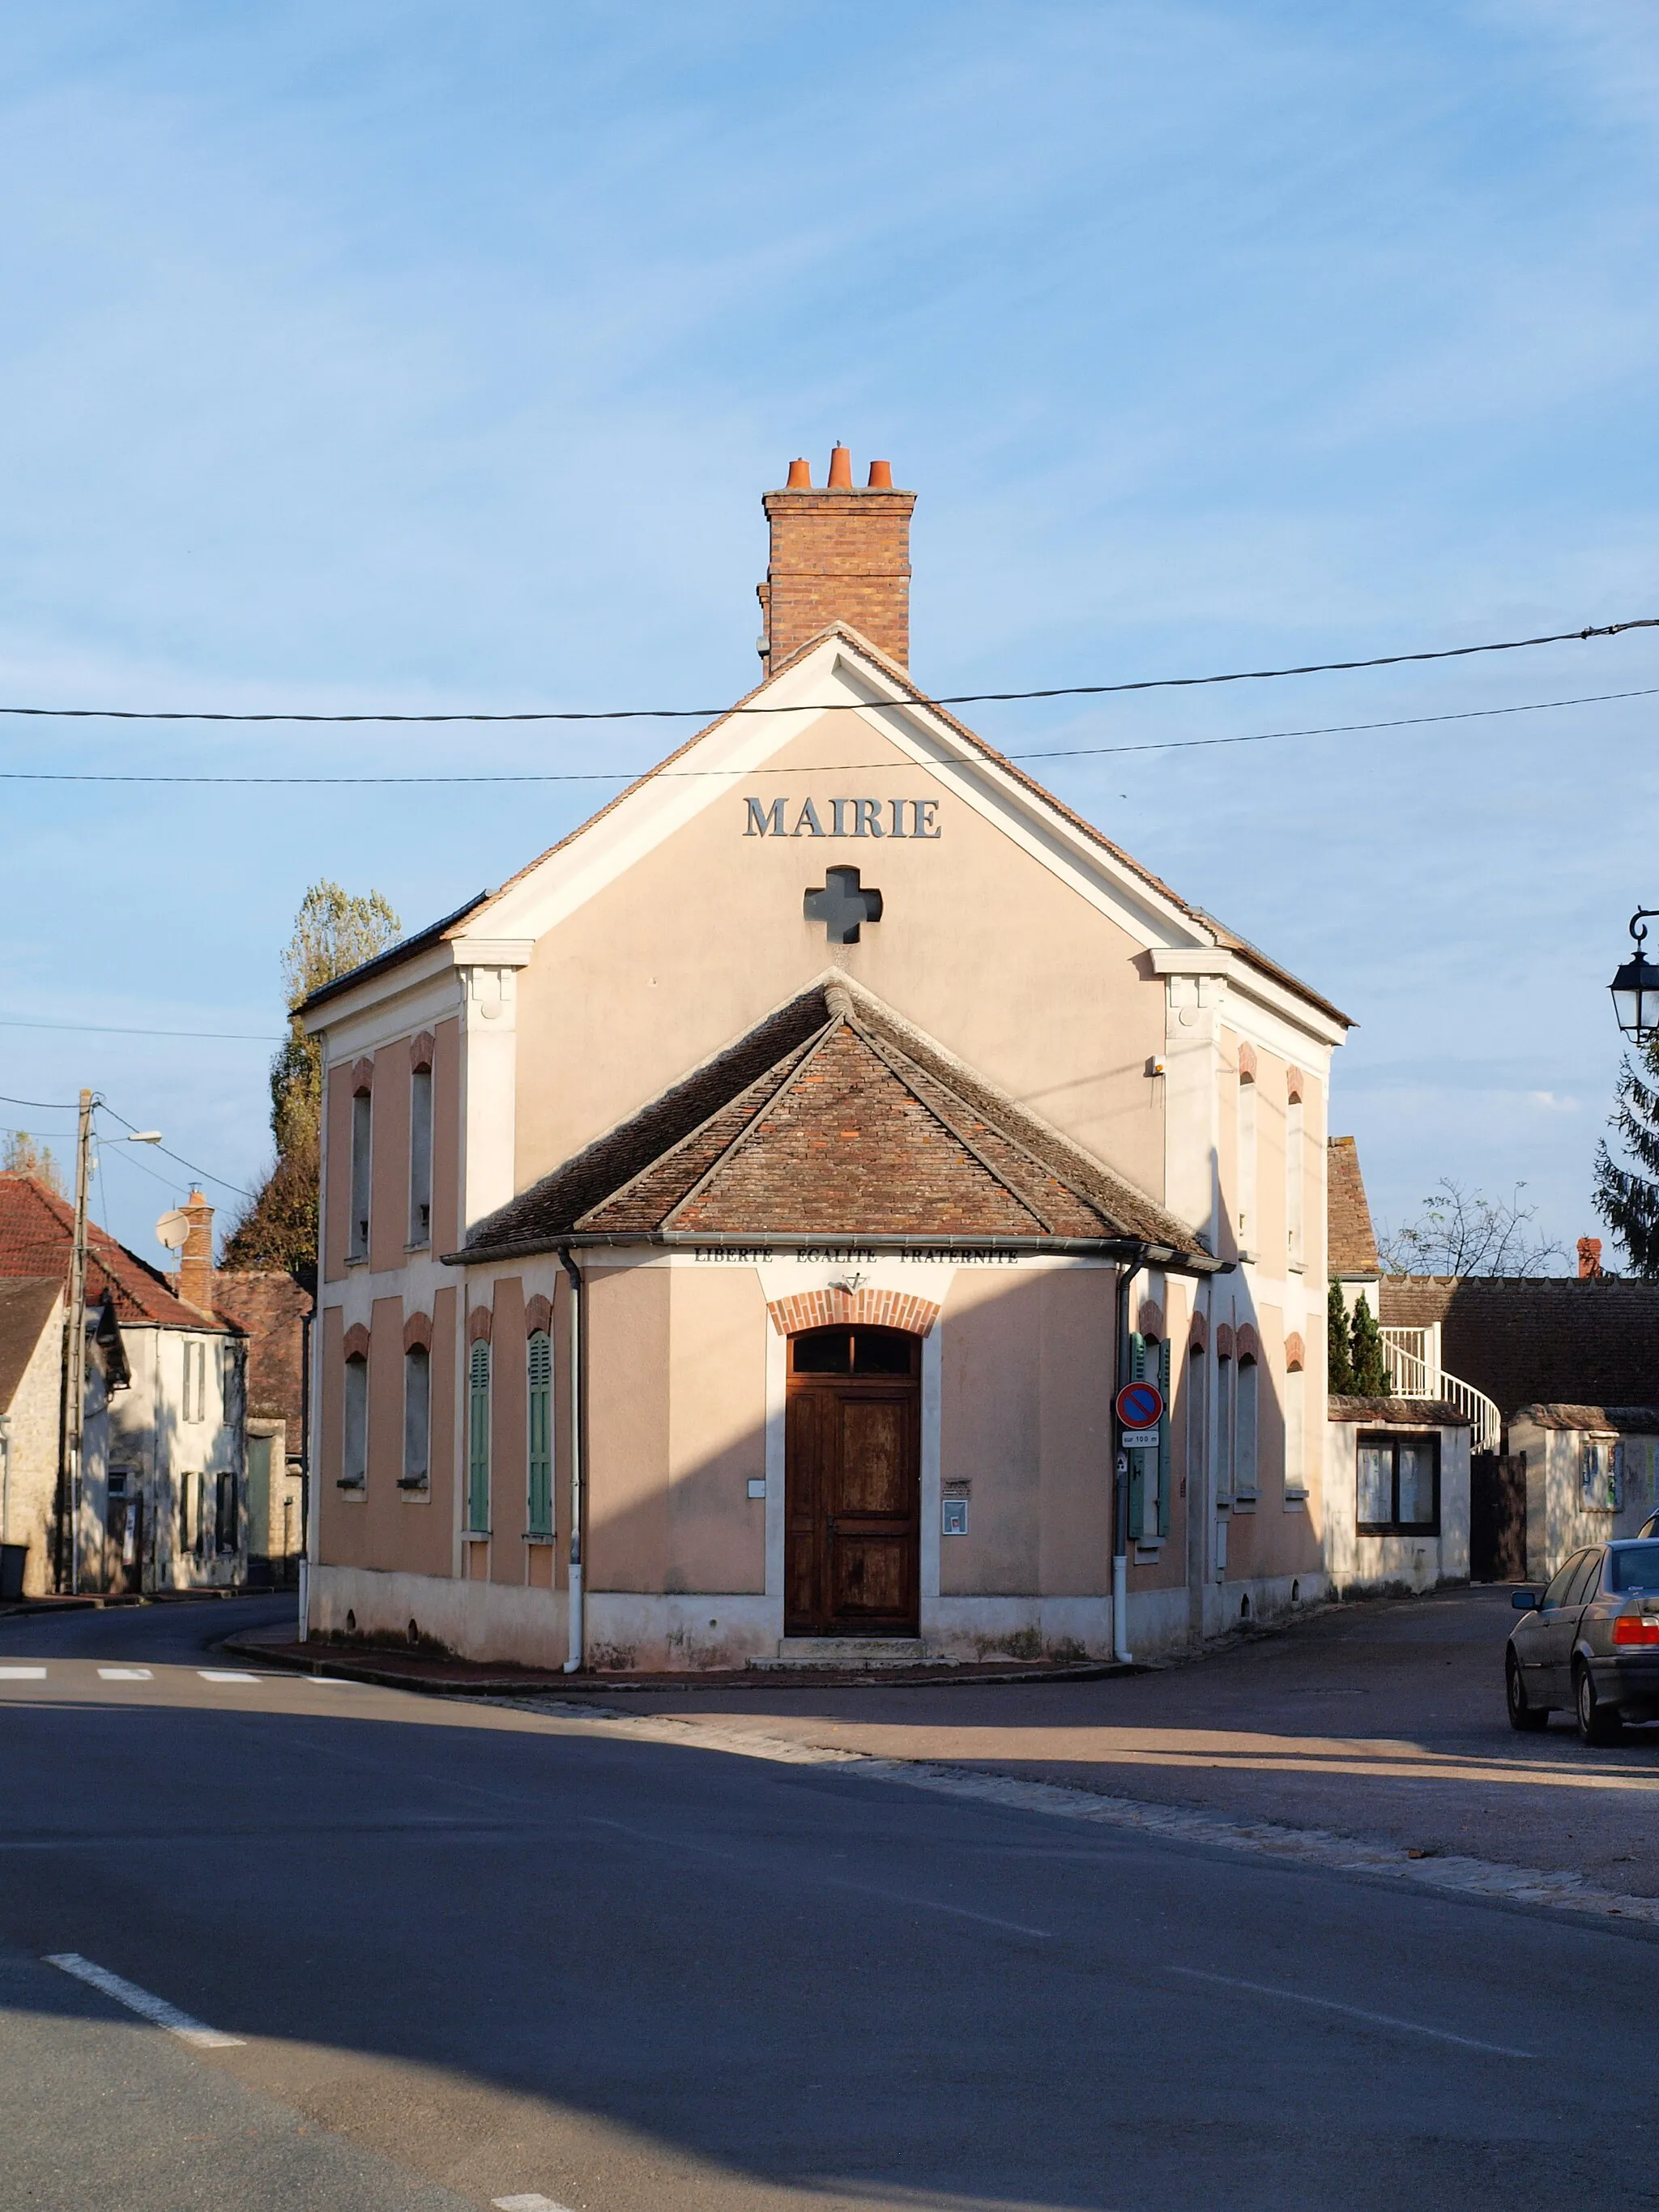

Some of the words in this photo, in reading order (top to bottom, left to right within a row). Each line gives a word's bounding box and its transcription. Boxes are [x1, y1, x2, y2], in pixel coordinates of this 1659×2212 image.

[742, 797, 942, 837] MAIRIE
[694, 1247, 773, 1263] LIBERTE
[795, 1248, 877, 1264] EGALITE
[899, 1248, 1019, 1264] FRATERNITE
